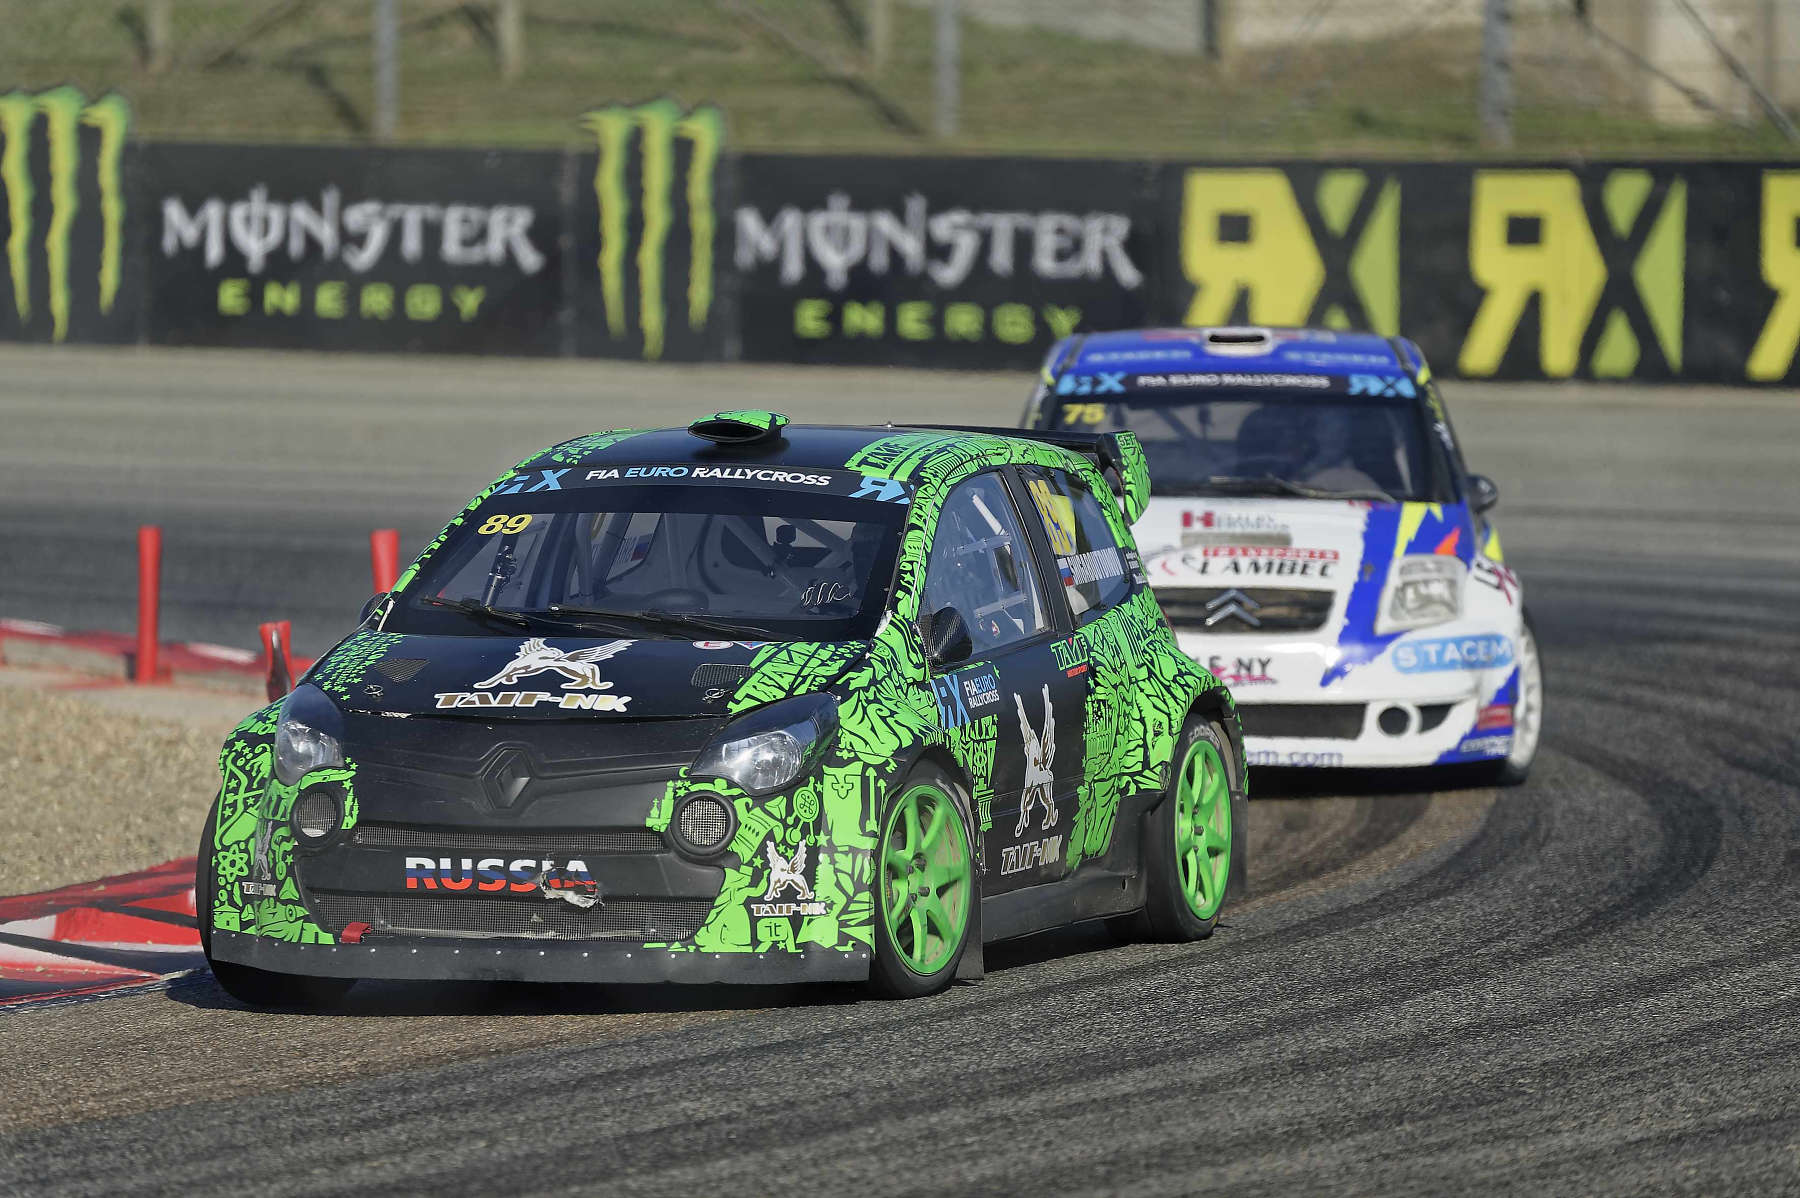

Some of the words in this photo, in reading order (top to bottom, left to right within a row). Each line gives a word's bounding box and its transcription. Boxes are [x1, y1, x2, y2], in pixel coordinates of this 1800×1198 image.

[161, 183, 546, 274] MONSTER
[733, 191, 1145, 290] MONSTER
[1457, 168, 1688, 378] RX
[217, 278, 486, 322] ENERGY
[794, 298, 1082, 343] ENERGY
[1137, 375, 1165, 388] FIA
[1168, 374, 1220, 388] EURO
[1221, 374, 1331, 389] RALLYCROSS
[1063, 403, 1106, 424] 75
[585, 469, 620, 481] FIA
[624, 467, 689, 478] EURO
[691, 467, 832, 486] RALLYCROSS
[477, 513, 533, 535] 89
[1396, 637, 1512, 668] STACEM
[434, 691, 632, 712] TAIF-NK
[968, 689, 1000, 709] RALLYCROSS
[405, 857, 598, 892] RUSSIA
[751, 902, 826, 917] TAIF-NK
